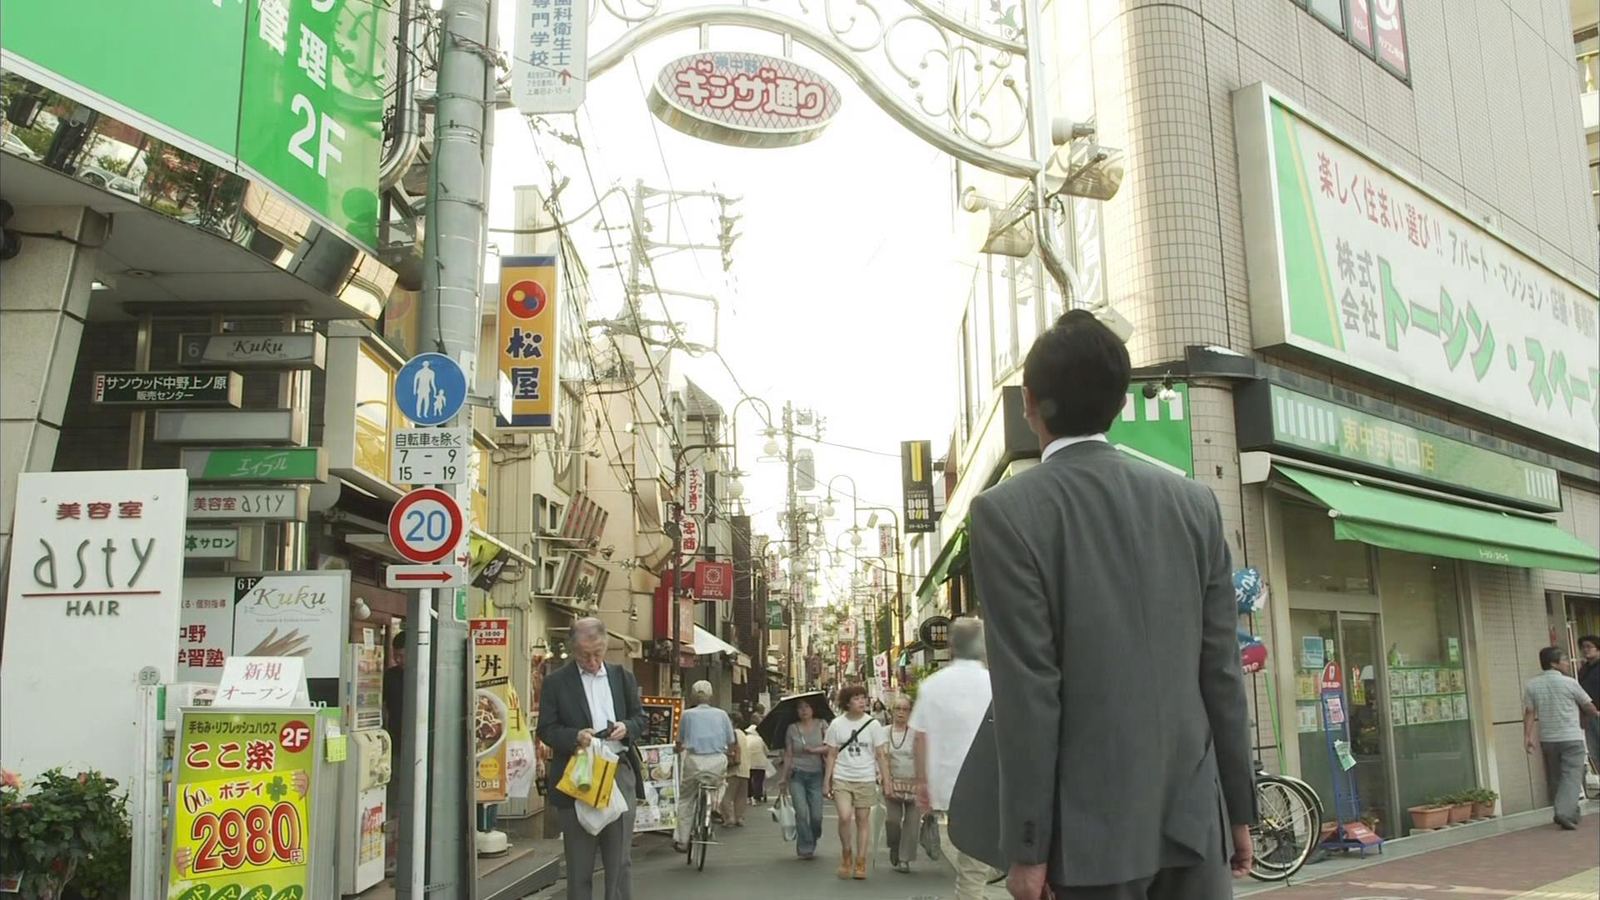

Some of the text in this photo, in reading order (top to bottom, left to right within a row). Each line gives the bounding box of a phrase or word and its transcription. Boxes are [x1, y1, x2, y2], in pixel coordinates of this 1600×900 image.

[676, 60, 826, 119] ギンザ通り
[287, 93, 346, 178] 2F
[1336, 236, 1376, 294] 株式
[1341, 287, 1381, 341] 会社
[188, 338, 285, 357] 6 Kuku
[506, 327, 545, 400] 松屋
[106, 376, 227, 390] サンウッド中野上ノ原
[136, 391, 194, 401] 販売センター
[395, 432, 462, 447] 自転車を除く
[230, 453, 290, 477] エイブル
[399, 449, 409, 464] 7
[448, 449, 458, 464] 9
[398, 466, 413, 481] 15
[442, 466, 457, 480] 19
[56, 501, 143, 520] 美容室
[193, 494, 285, 513] 美容室 asty
[405, 510, 446, 541] 20
[33, 538, 155, 589] asty
[237, 578, 257, 590] 6F
[253, 586, 326, 609] Kuku
[66, 601, 119, 616] HAIR
[141, 671, 156, 682] 3F
[243, 662, 283, 680] 新規
[222, 684, 292, 701] オープン
[188, 721, 278, 735] 手もみ・リフレッシュハウス
[282, 727, 309, 748] 2F
[186, 740, 276, 772] ここ楽
[219, 781, 264, 800] ボディ
[190, 801, 302, 873] 2980
